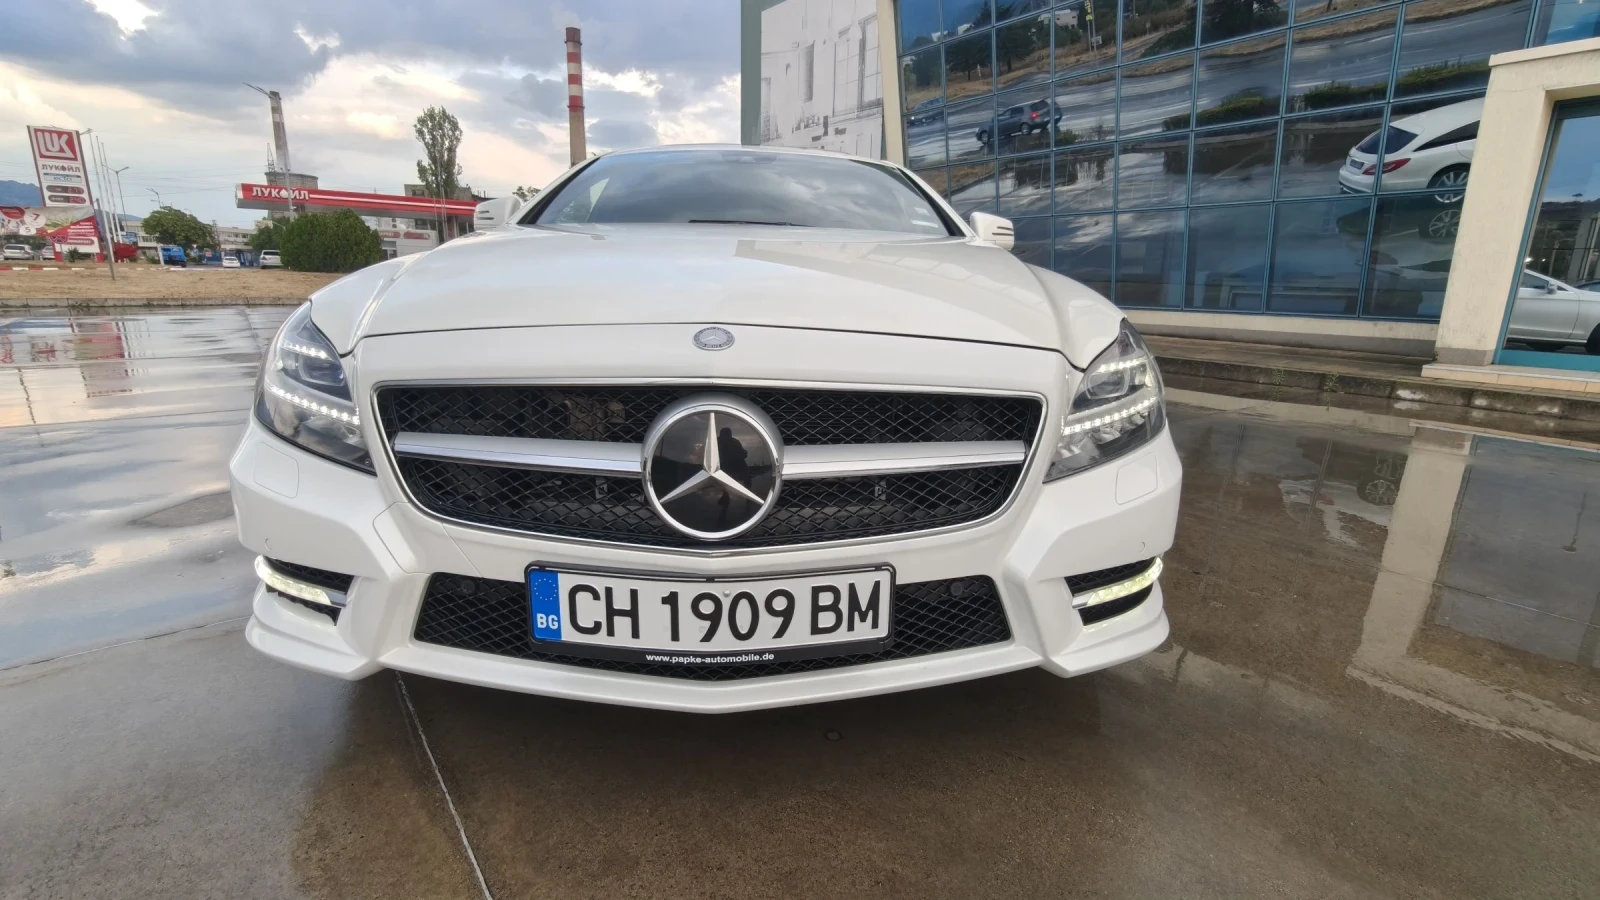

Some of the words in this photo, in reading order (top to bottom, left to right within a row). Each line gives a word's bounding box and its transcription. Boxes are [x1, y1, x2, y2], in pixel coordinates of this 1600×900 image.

[568, 583, 640, 640] CH
[661, 588, 796, 643] 1909
[810, 580, 882, 636] BM
[536, 613, 559, 629] BG
[645, 652, 775, 665] www.papke-automobile.de
